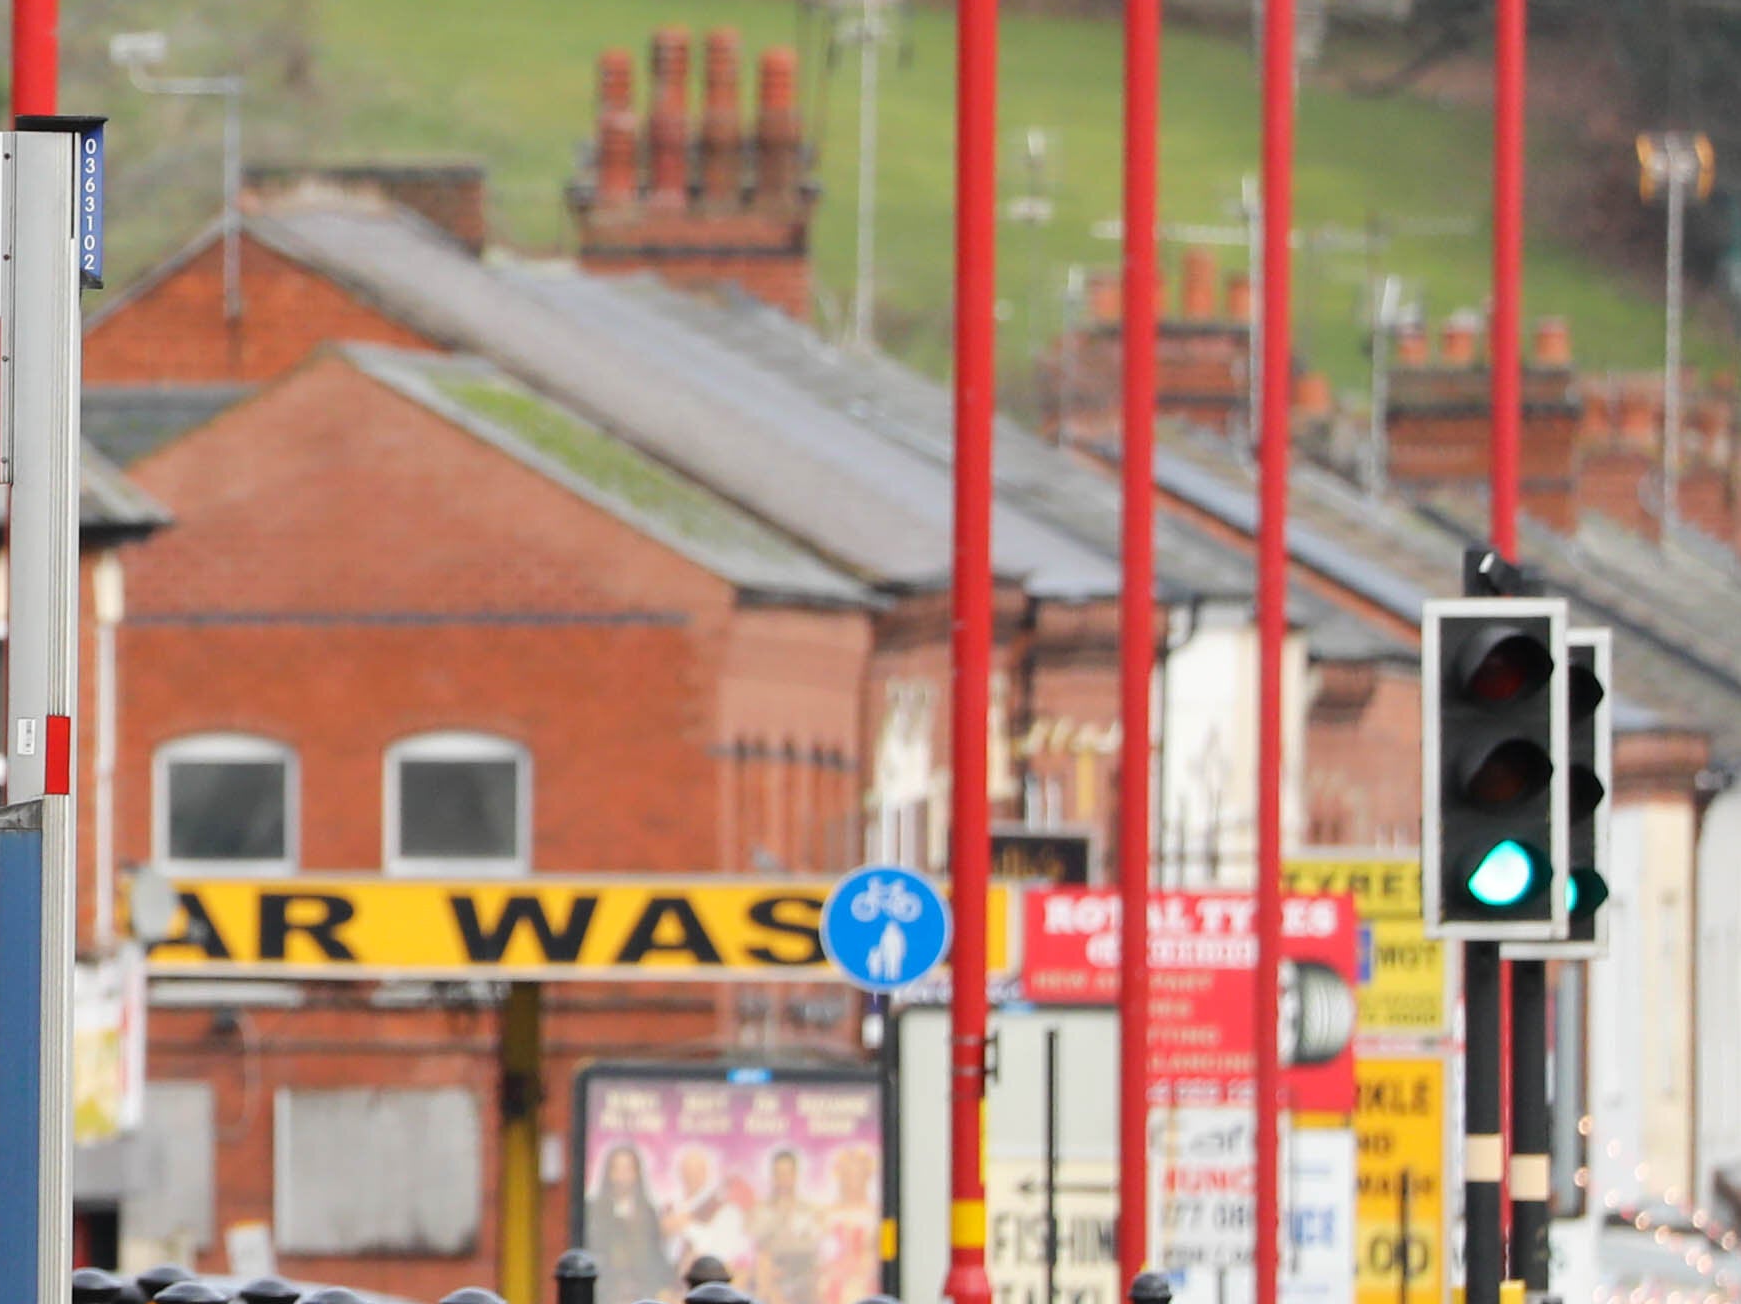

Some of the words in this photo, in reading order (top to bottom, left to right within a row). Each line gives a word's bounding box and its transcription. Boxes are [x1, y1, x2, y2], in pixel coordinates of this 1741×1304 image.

[83, 138, 98, 272] 0363102
[146, 892, 358, 962] AR
[449, 893, 828, 966] WAS
[1195, 897, 1339, 938] TYES
